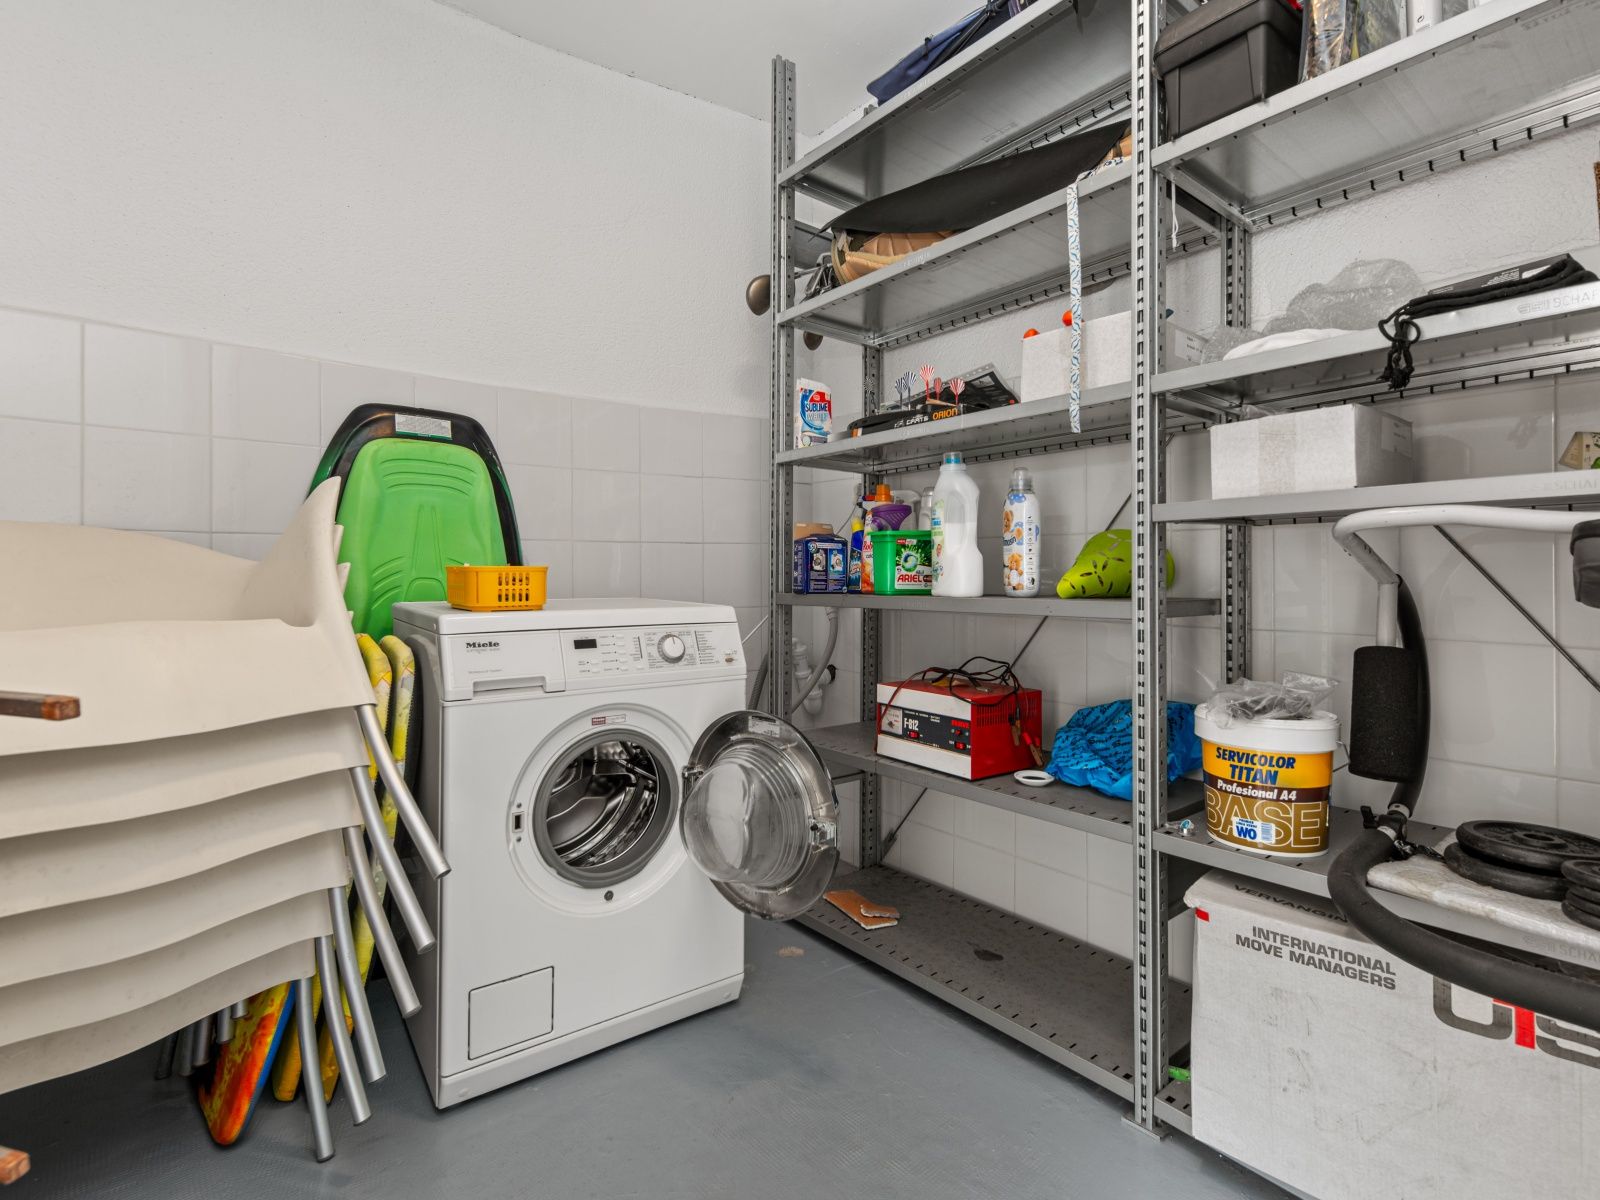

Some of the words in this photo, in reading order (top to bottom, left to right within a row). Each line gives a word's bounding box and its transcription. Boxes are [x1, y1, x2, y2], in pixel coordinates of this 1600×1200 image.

[932, 408, 958, 421] ORION
[897, 574, 922, 583] ARIEL
[465, 641, 500, 649] Miele
[1216, 747, 1296, 770] SERVICOLOR
[1230, 764, 1279, 785] TITAN
[1217, 779, 1278, 800] Profesional
[1279, 790, 1297, 801] A4
[1206, 786, 1322, 848] BASE
[1236, 825, 1257, 840] WO
[1252, 926, 1397, 976] INTERNATIONAL
[1235, 933, 1283, 959] MOVE
[1289, 950, 1397, 991] MANAGERS
